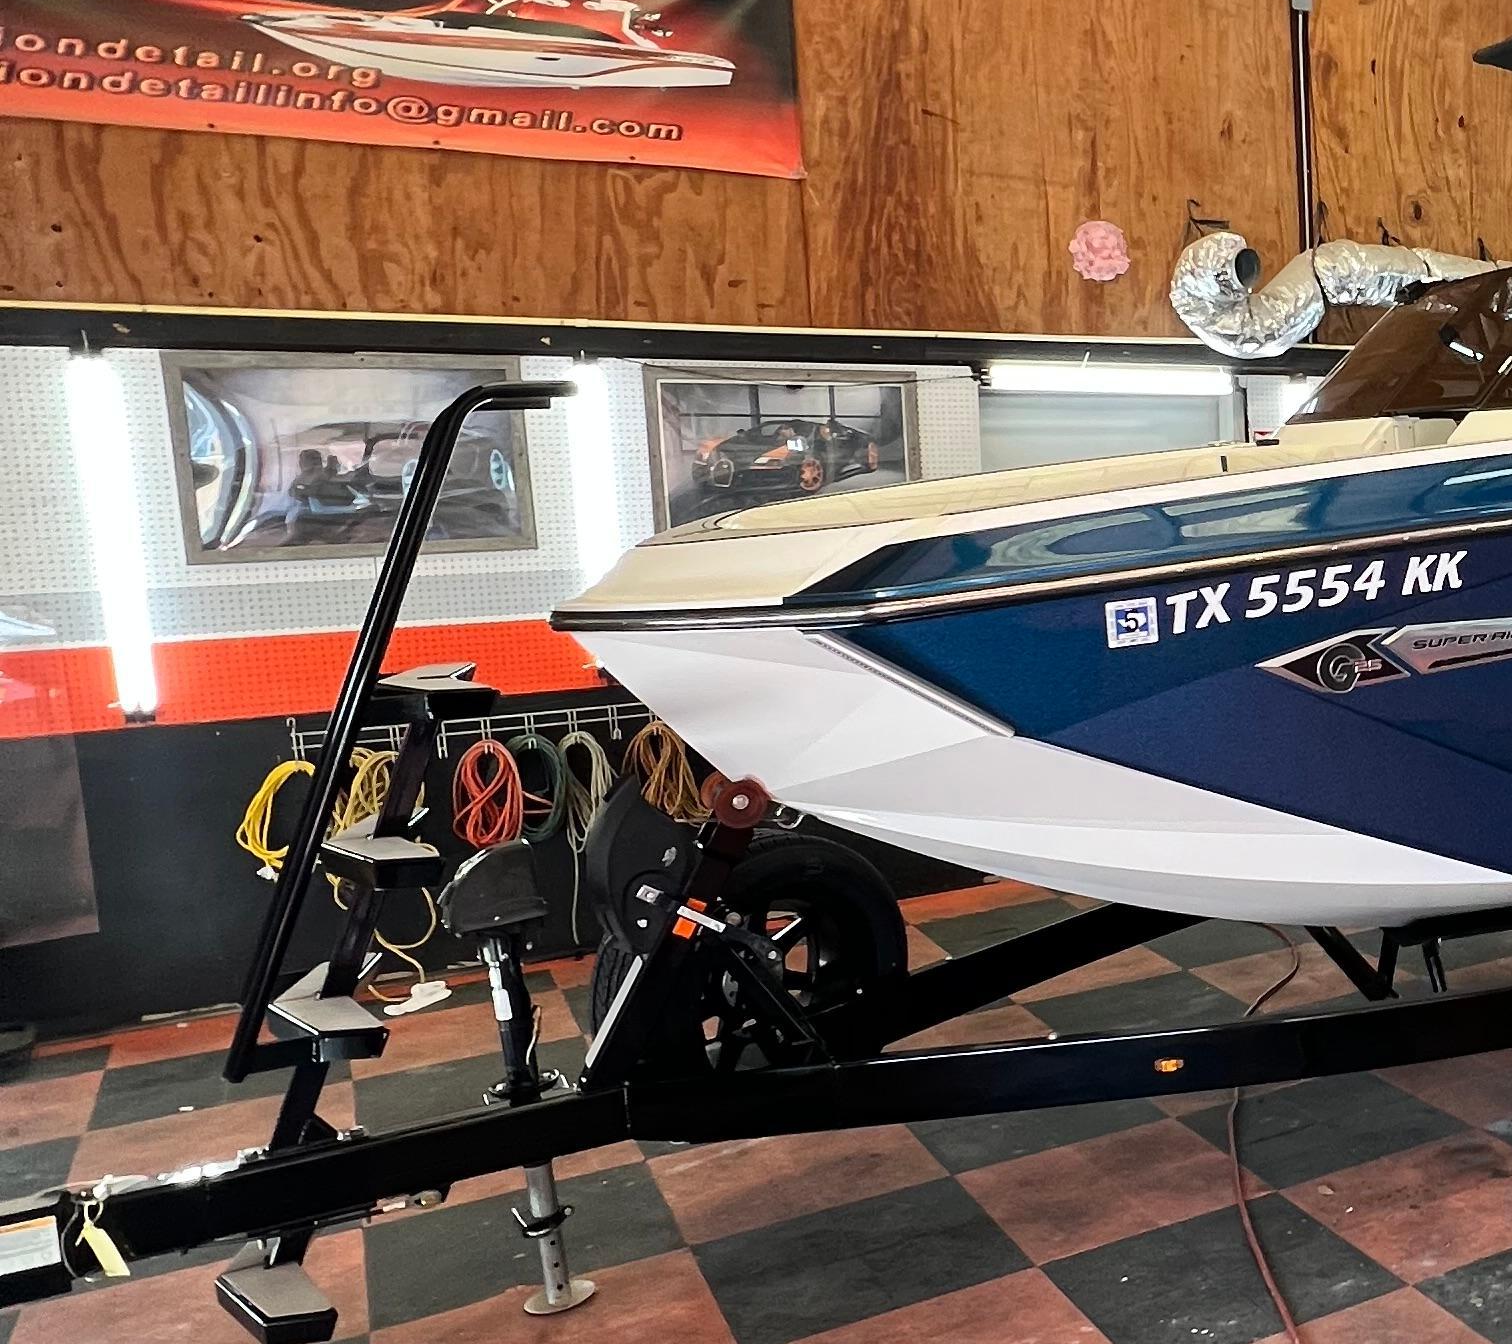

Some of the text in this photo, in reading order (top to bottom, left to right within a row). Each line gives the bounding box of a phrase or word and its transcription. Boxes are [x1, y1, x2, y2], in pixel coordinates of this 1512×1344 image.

[1165, 550, 1468, 635] TX 5554 KK
[1411, 633, 1487, 650] SUPER
